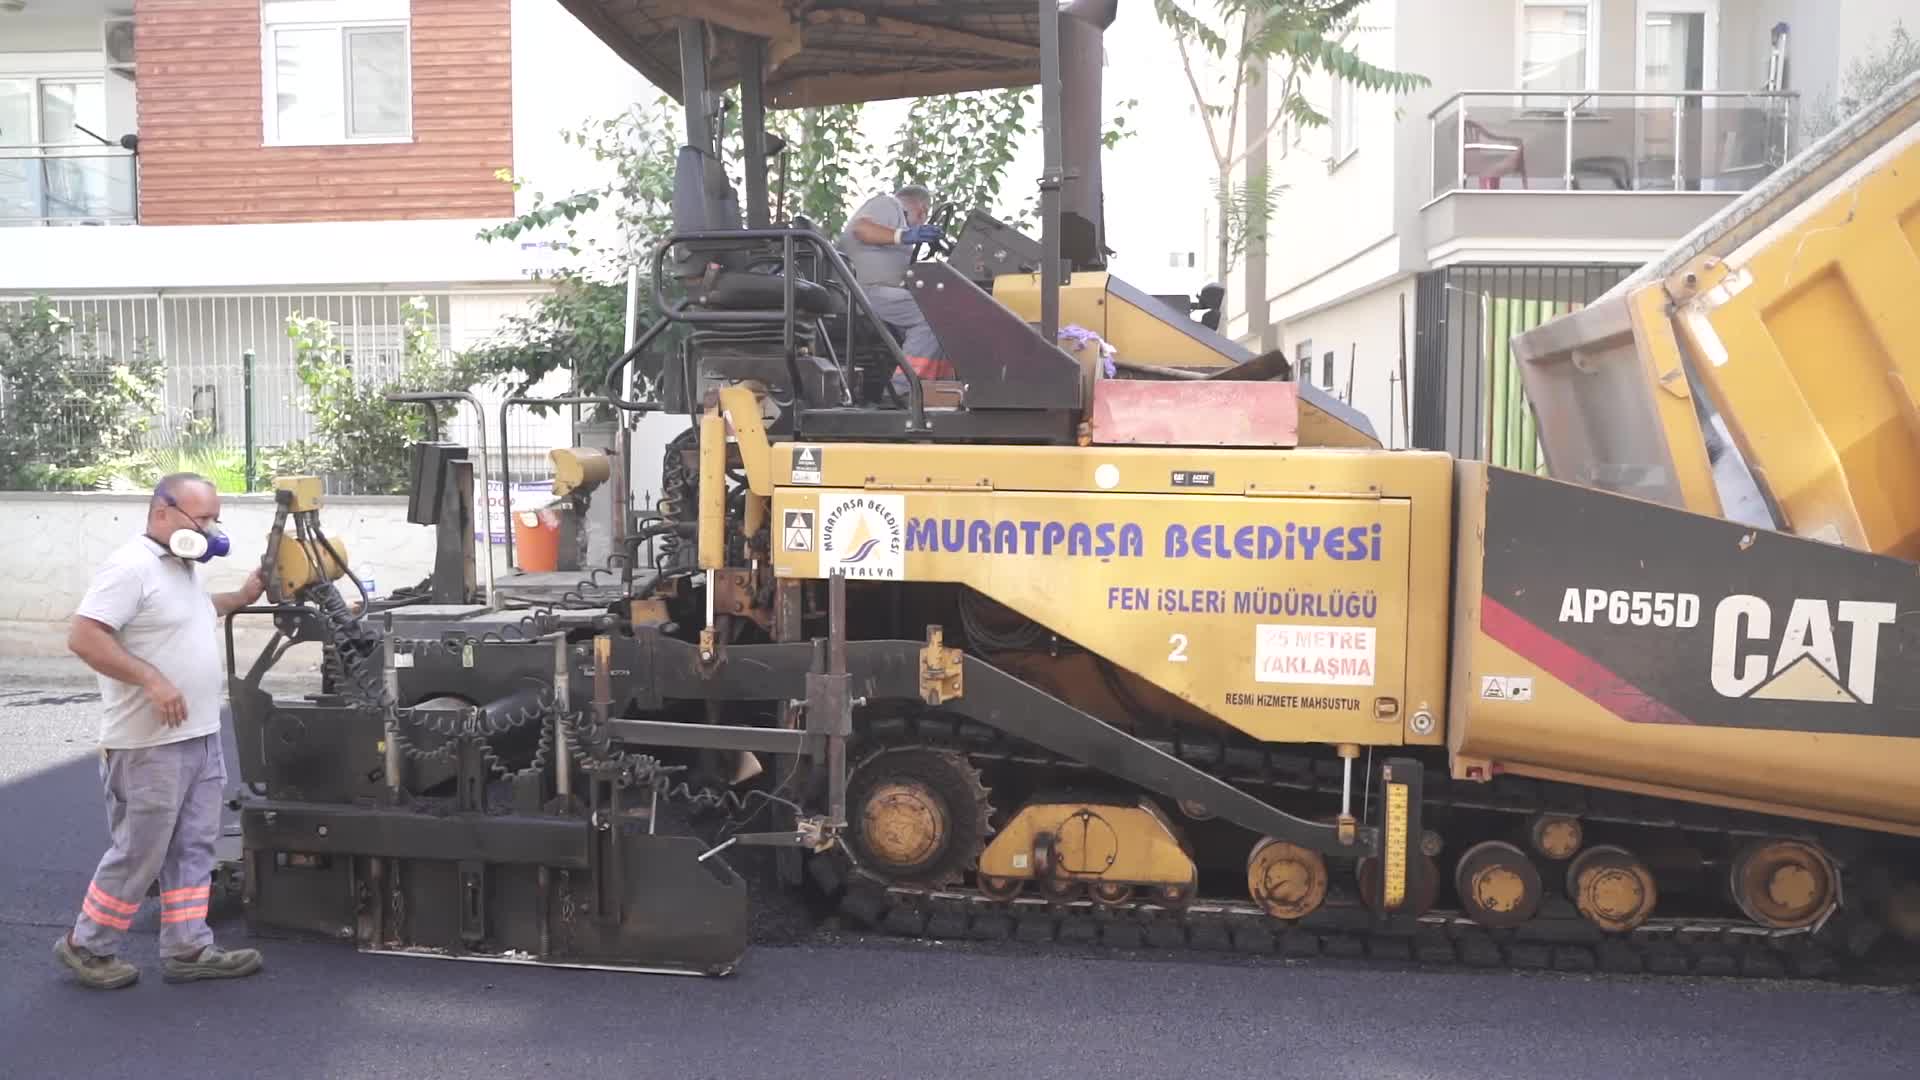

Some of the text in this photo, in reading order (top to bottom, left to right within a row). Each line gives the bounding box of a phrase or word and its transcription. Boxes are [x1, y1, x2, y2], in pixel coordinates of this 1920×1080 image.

[904, 517, 1144, 563] MURATPAŞA
[829, 566, 893, 577] ANTALYA
[1108, 587, 1149, 610] FEN
[1233, 586, 1377, 618] MÜDÜRLÜĞÜ
[1167, 633, 1188, 662] 2
[1295, 631, 1367, 650] METRE
[1558, 587, 1896, 704] AP655D CAT
[1262, 655, 1372, 680] YAKLAŞMA
[1300, 697, 1361, 711] MAHSUSTUR
